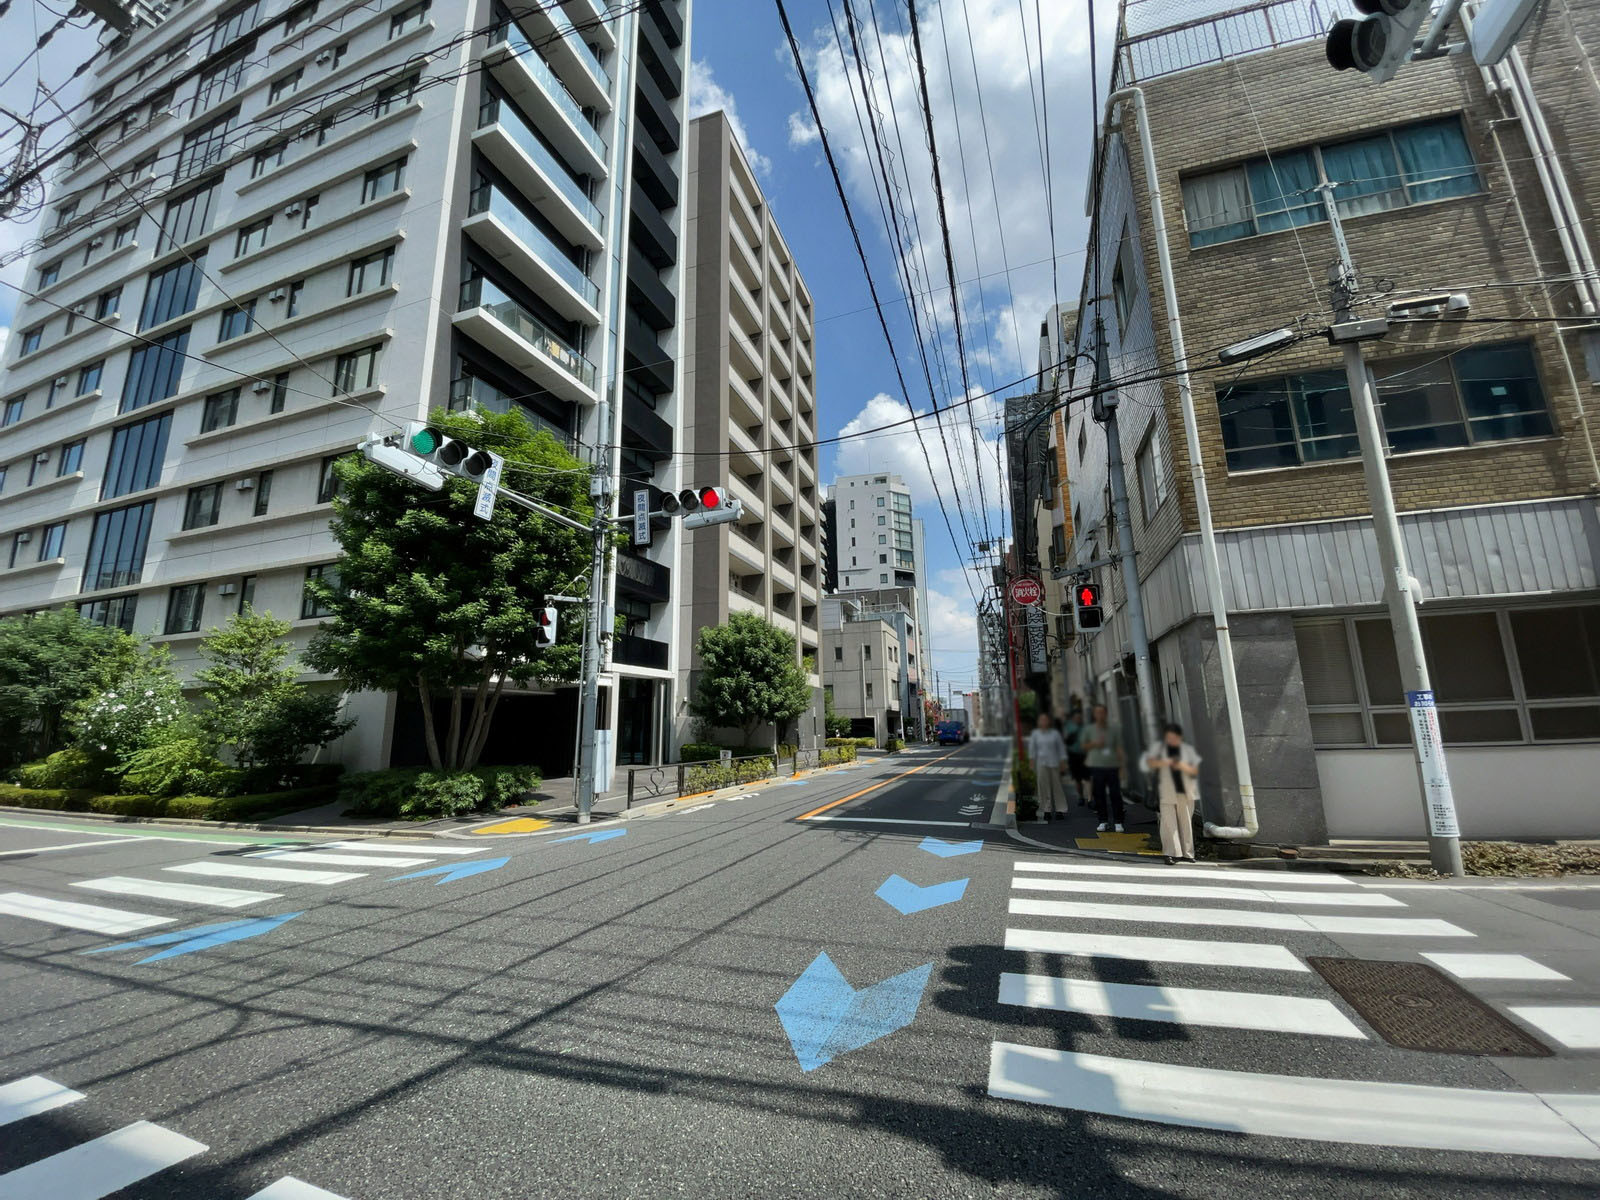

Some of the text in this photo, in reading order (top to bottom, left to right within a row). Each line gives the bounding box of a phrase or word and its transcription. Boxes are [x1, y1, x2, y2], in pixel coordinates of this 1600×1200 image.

[637, 494, 646, 541] 夜間点滅式
[1015, 586, 1038, 598] 消火栓
